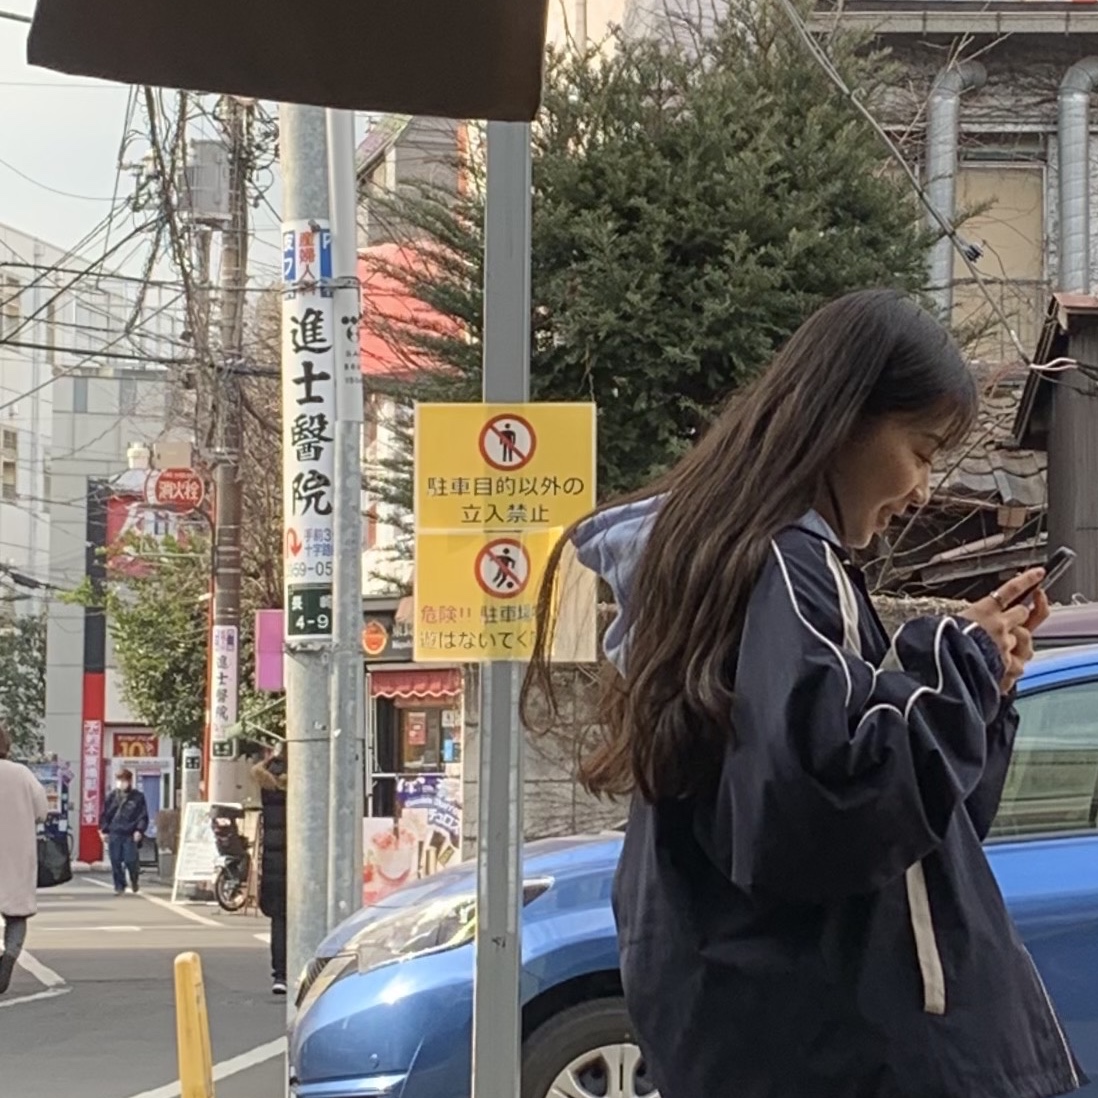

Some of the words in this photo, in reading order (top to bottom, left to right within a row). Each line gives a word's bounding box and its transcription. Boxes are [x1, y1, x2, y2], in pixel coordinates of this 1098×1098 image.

[291, 308, 333, 516] 進士醫院
[427, 476, 585, 497] 駐車目的以外の
[461, 503, 550, 524] 立入禁止
[295, 614, 329, 630] 4-9
